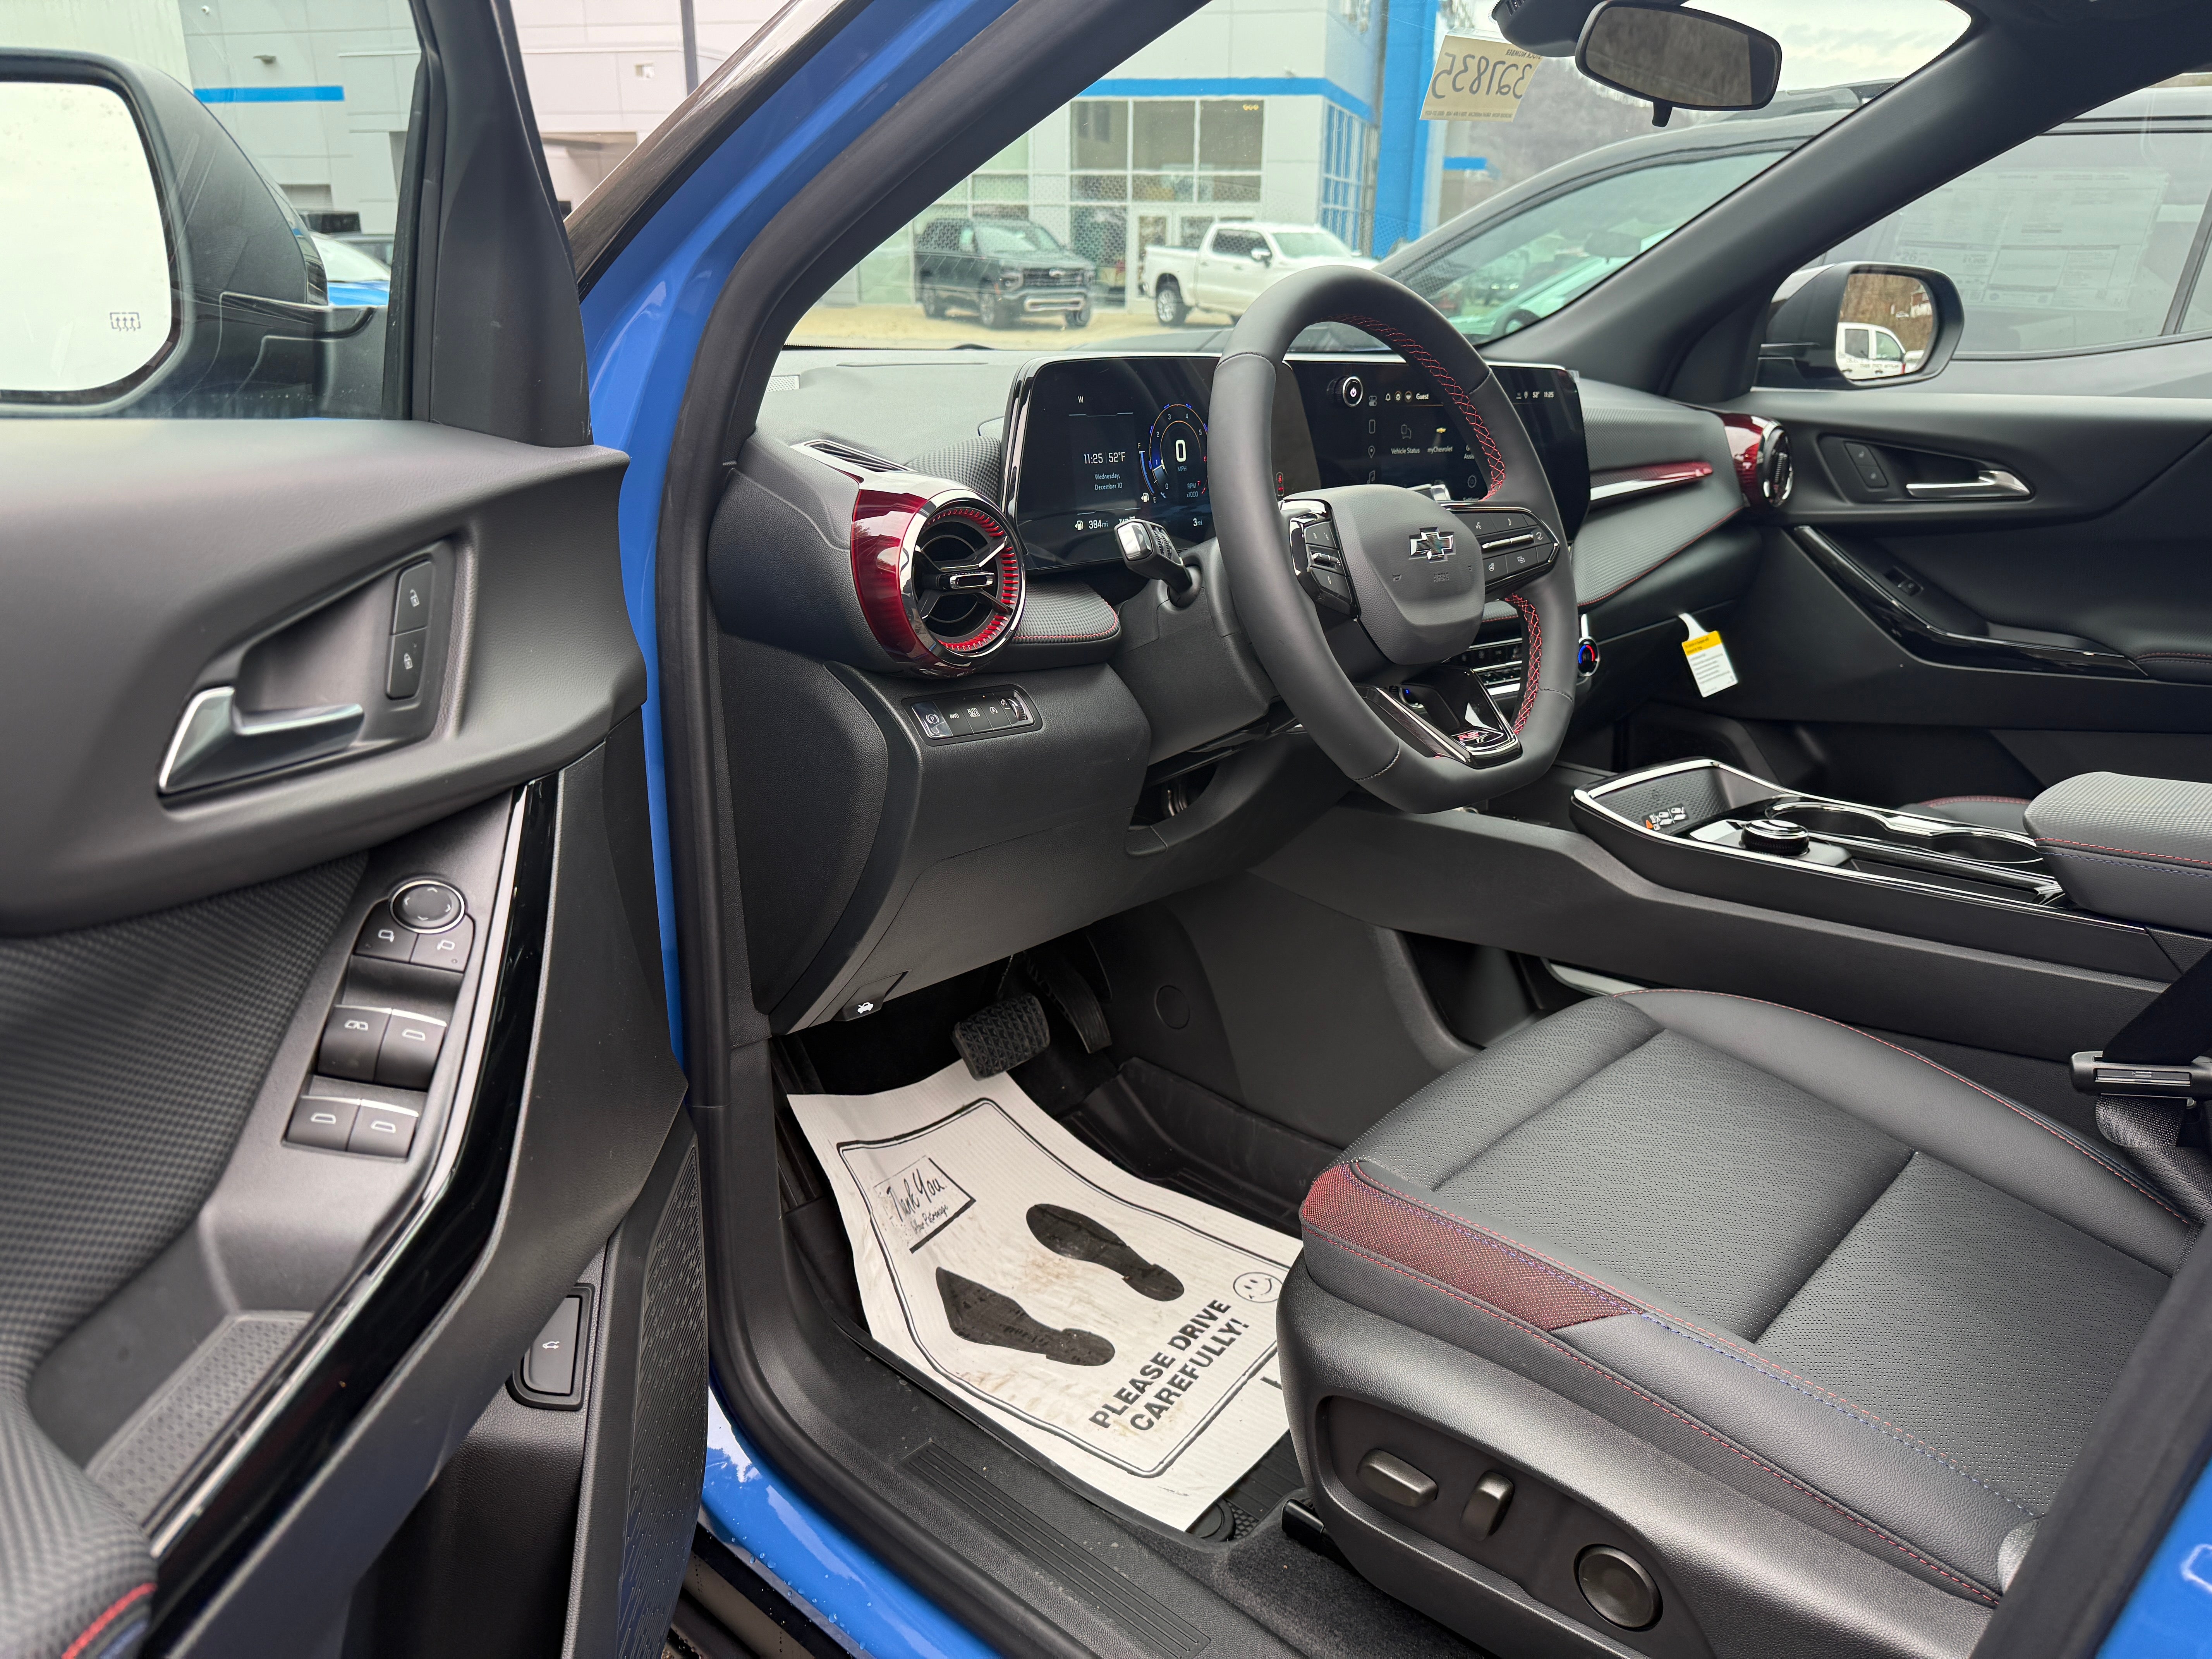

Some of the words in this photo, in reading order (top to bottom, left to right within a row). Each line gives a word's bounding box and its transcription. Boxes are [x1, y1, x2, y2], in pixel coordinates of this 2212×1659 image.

[1084, 453, 1103, 464] 11:25
[1108, 452, 1125, 463] 52°F
[1175, 439, 1187, 462] 0
[1427, 446, 1453, 454] myChevrolet
[912, 1168, 945, 1204] You
[1088, 1351, 1177, 1429] PLEASE
[1168, 1299, 1231, 1351] DRIVE
[1130, 1318, 1250, 1431] CAREFULLY!
